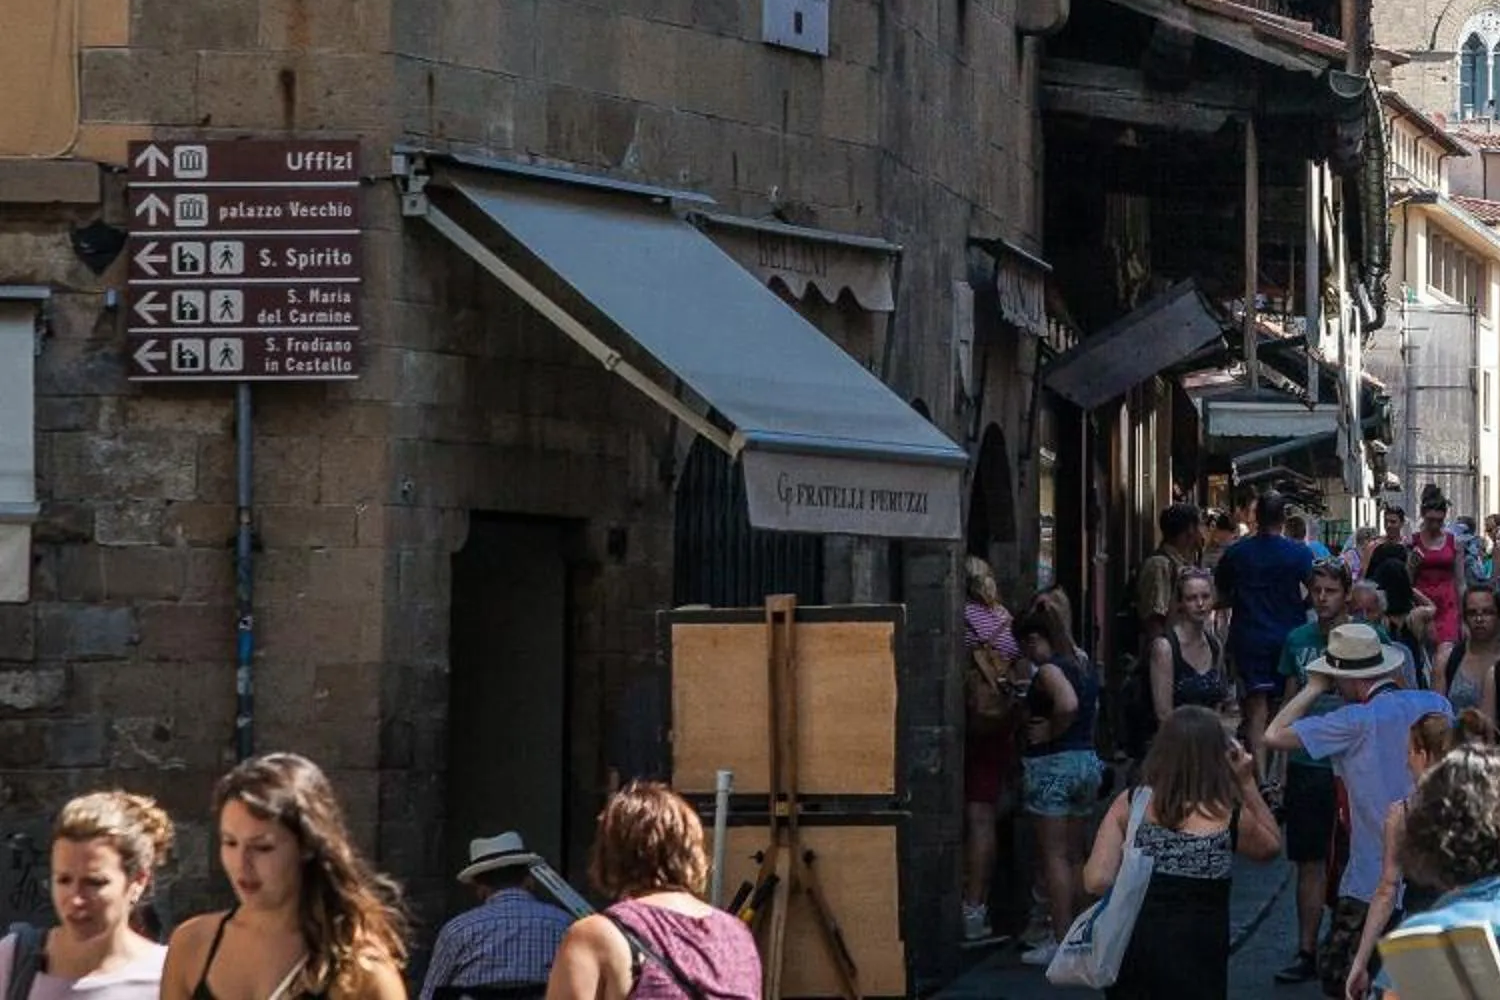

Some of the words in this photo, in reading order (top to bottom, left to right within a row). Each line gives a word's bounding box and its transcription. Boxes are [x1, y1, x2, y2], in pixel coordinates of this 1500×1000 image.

[286, 151, 353, 171] Uffizi
[219, 201, 282, 221] palazzo
[289, 201, 353, 217] Vecchio
[260, 248, 277, 267] S.
[286, 248, 353, 271] Spirito
[287, 288, 303, 304] S.
[309, 288, 352, 304] Maria
[257, 308, 281, 323] del
[289, 308, 353, 323] Carmine
[265, 336, 281, 352] S.
[287, 336, 353, 352] Frediano
[265, 356, 280, 371] in
[285, 356, 353, 372] Cestello
[797, 483, 864, 509] FRATELLI
[871, 489, 928, 515] PERUZZI
